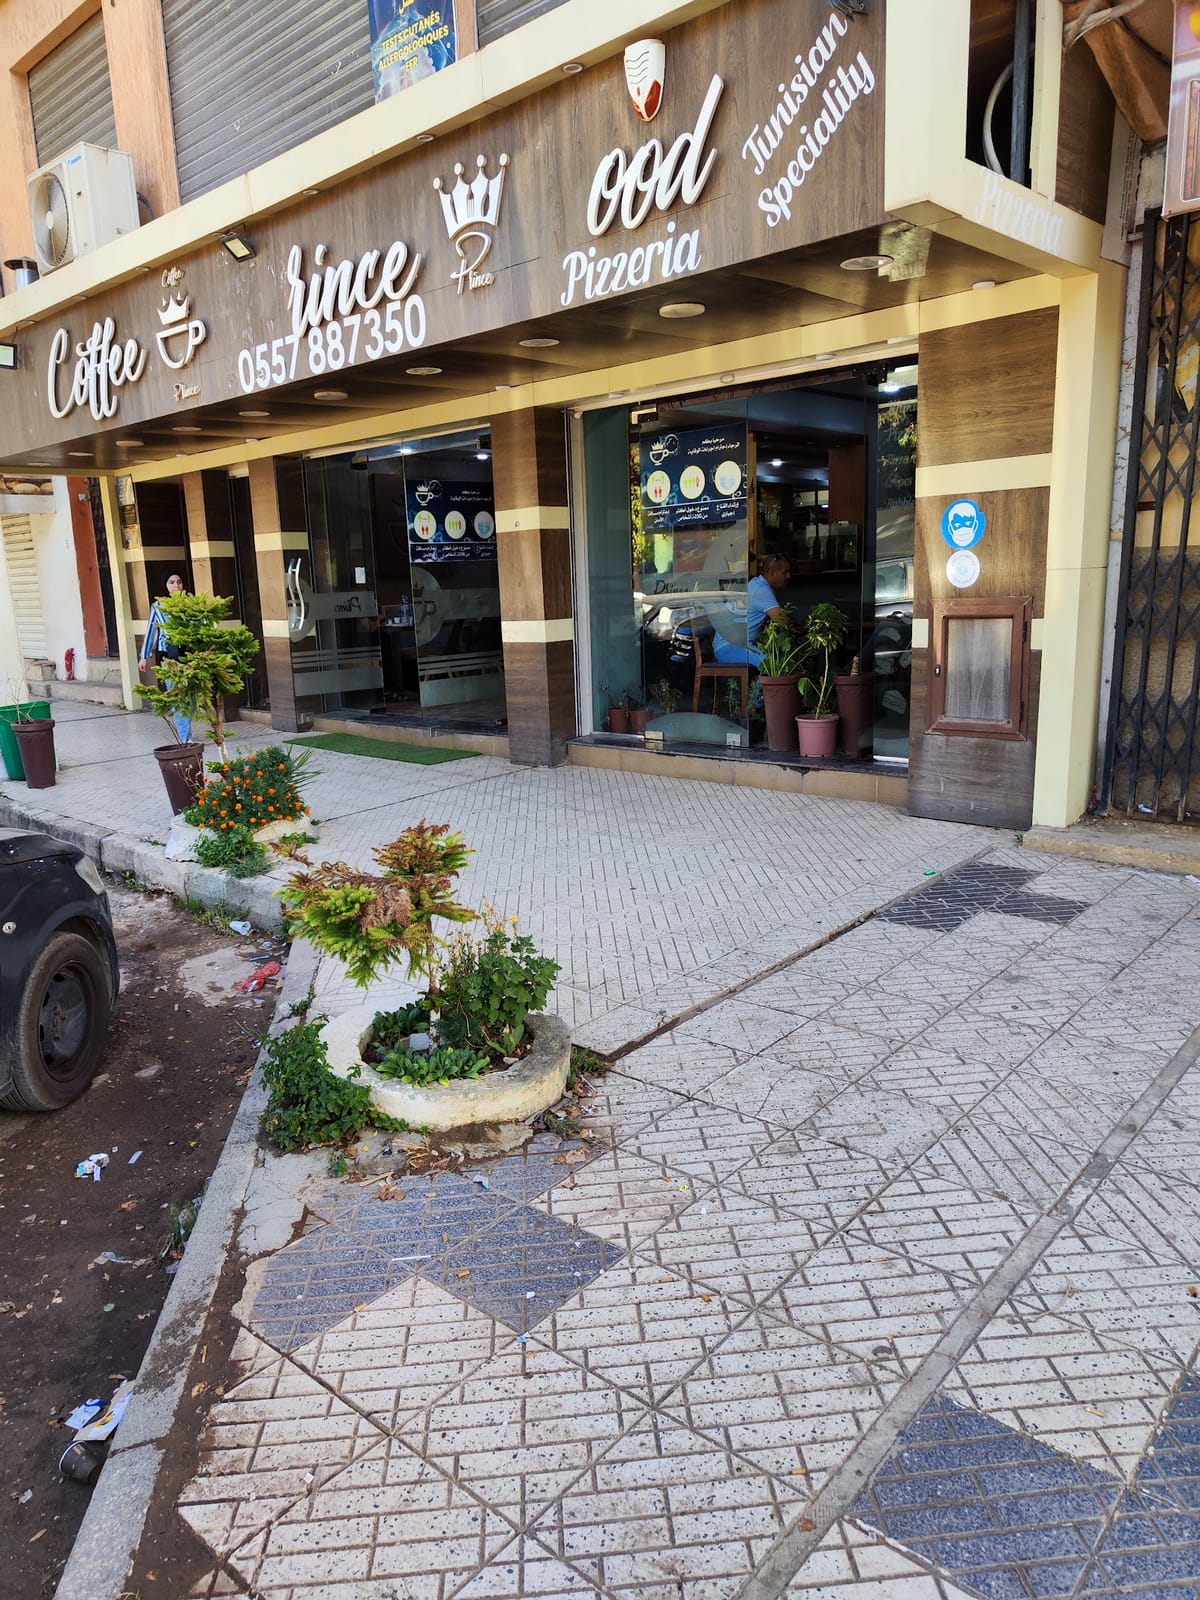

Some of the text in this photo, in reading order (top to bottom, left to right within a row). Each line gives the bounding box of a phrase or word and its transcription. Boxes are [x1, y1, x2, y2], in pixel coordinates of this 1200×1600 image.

[379, 25, 449, 72] ALLERGOLOGIQUES
[381, 10, 440, 52] TESTS CUTANÉS
[741, 13, 848, 176] Tunisian
[758, 51, 876, 228] Speciality
[560, 221, 701, 306] Pizzeria
[48, 316, 147, 421] Coffee
[238, 294, 427, 394] 0557 887350
